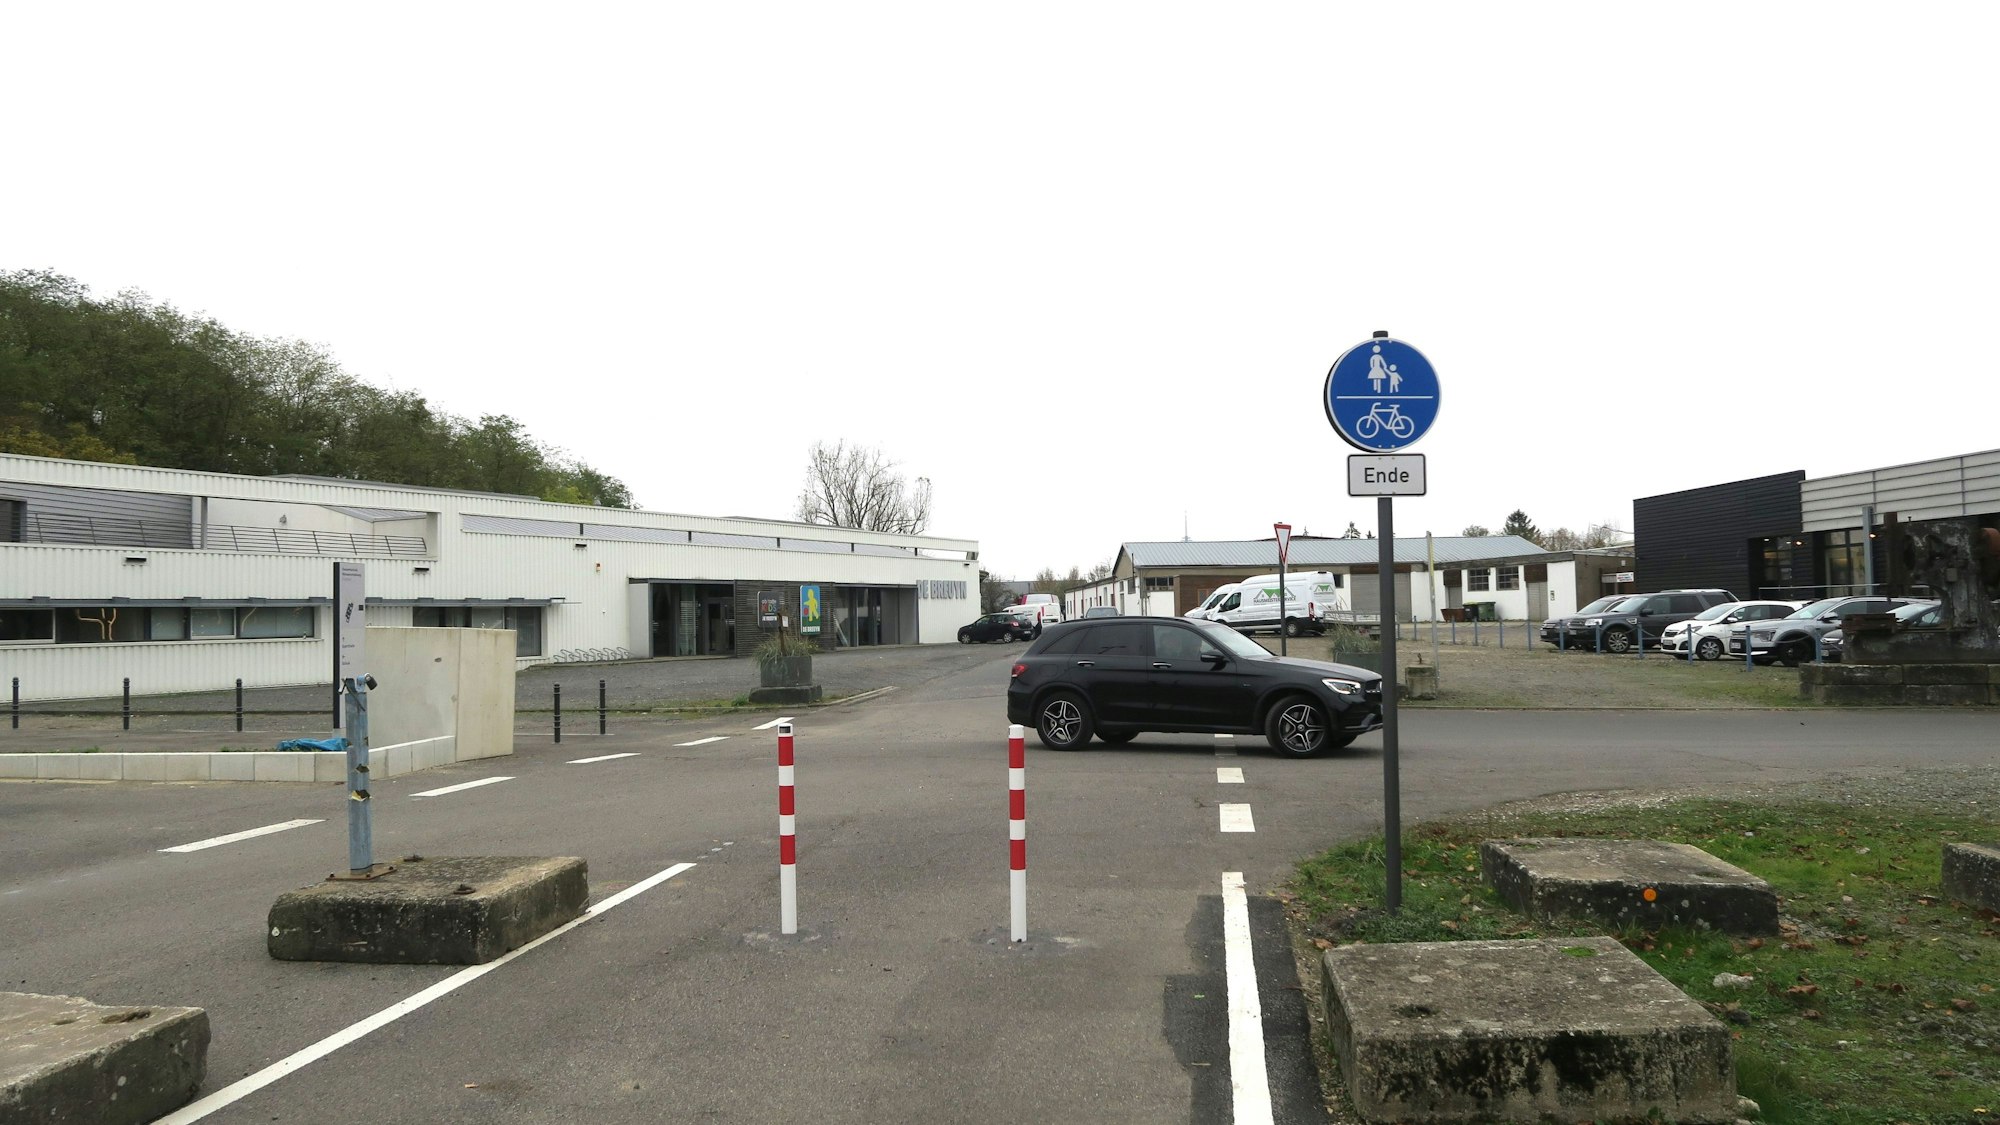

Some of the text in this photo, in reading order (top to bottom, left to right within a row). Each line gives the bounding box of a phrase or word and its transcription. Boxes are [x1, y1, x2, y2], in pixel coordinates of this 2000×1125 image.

[1364, 467, 1409, 483] Ende
[916, 580, 967, 599] DE BREUYN
